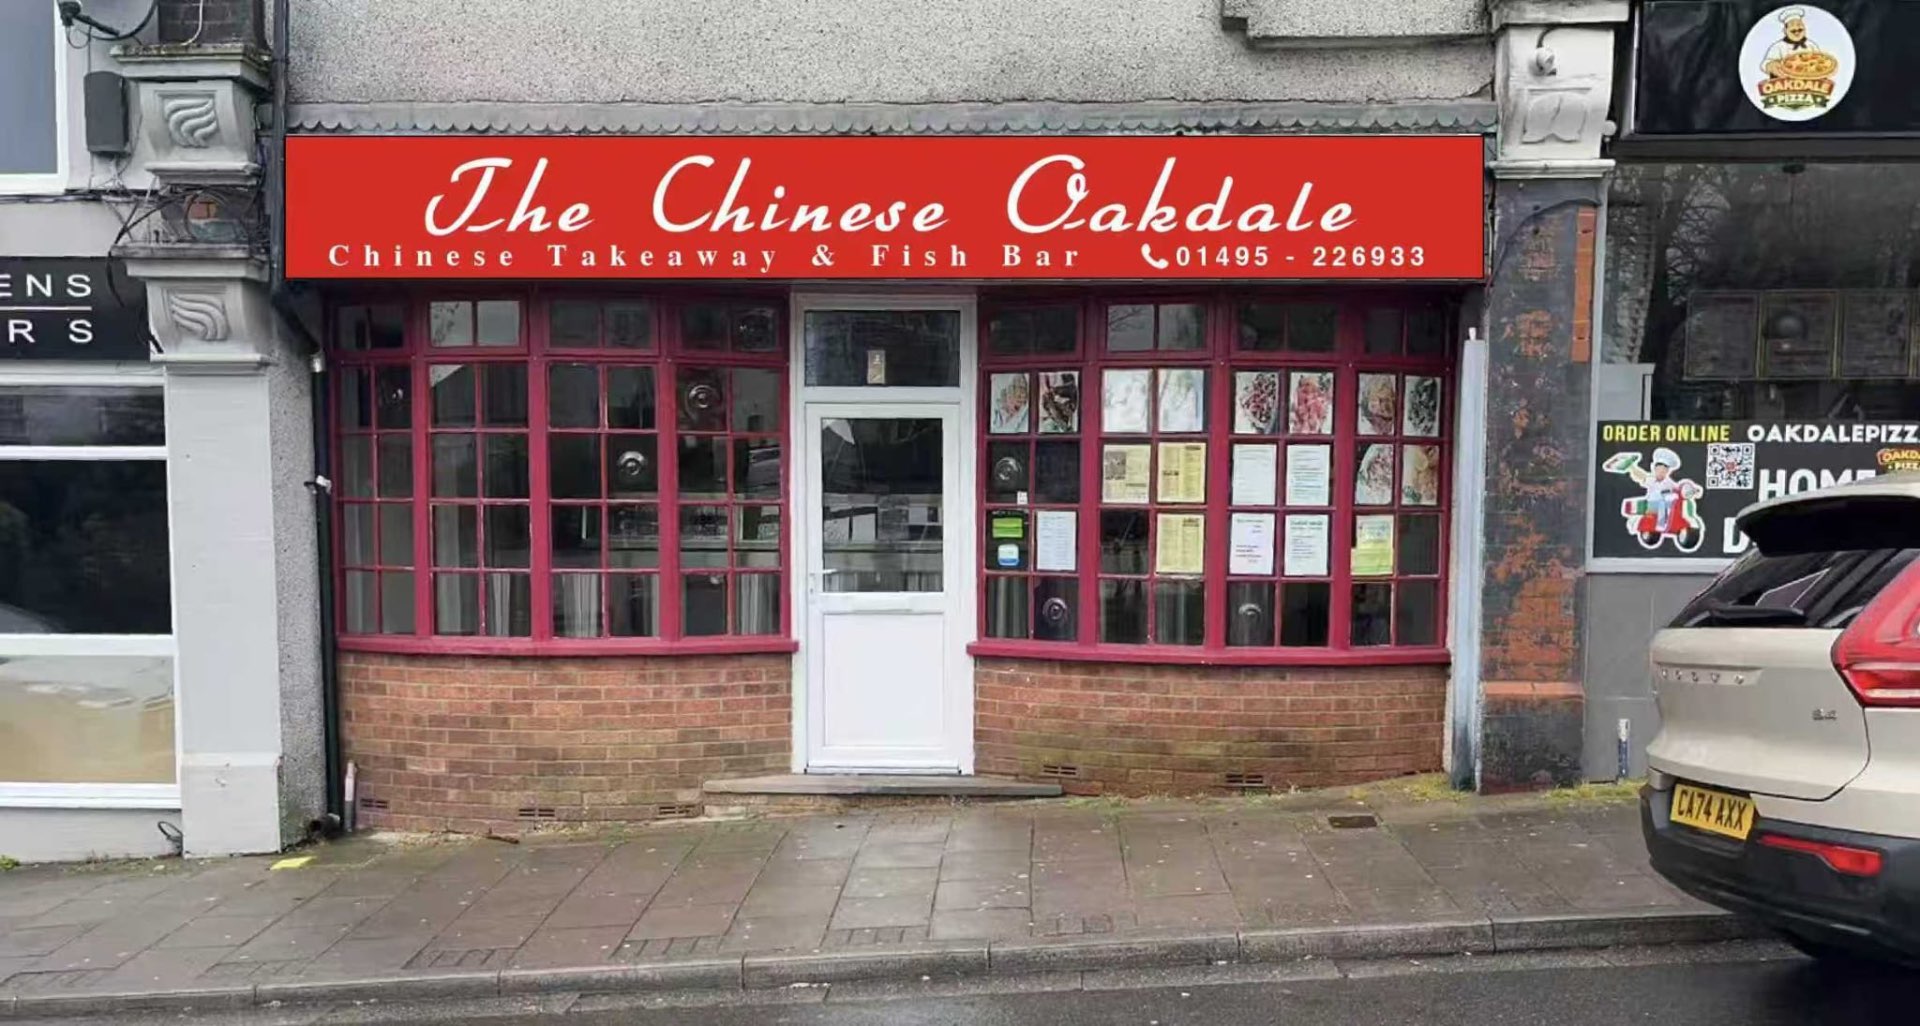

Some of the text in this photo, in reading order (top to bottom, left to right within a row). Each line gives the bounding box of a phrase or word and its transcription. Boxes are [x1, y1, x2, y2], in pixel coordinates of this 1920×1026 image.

[1762, 80, 1829, 94] OAKDALE
[1776, 94, 1814, 104] PIZZA
[424, 154, 1357, 236] The Chinese Oakdale
[328, 244, 1079, 273] Chinese Takeaway & Fish Bar
[1175, 246, 1269, 266] 01495
[1312, 246, 1426, 266] 226933
[1602, 424, 1731, 442] ORDER ONLINE
[1747, 424, 1920, 443] OAKDALEPIZZ
[1677, 788, 1748, 832] CA74 AXX
